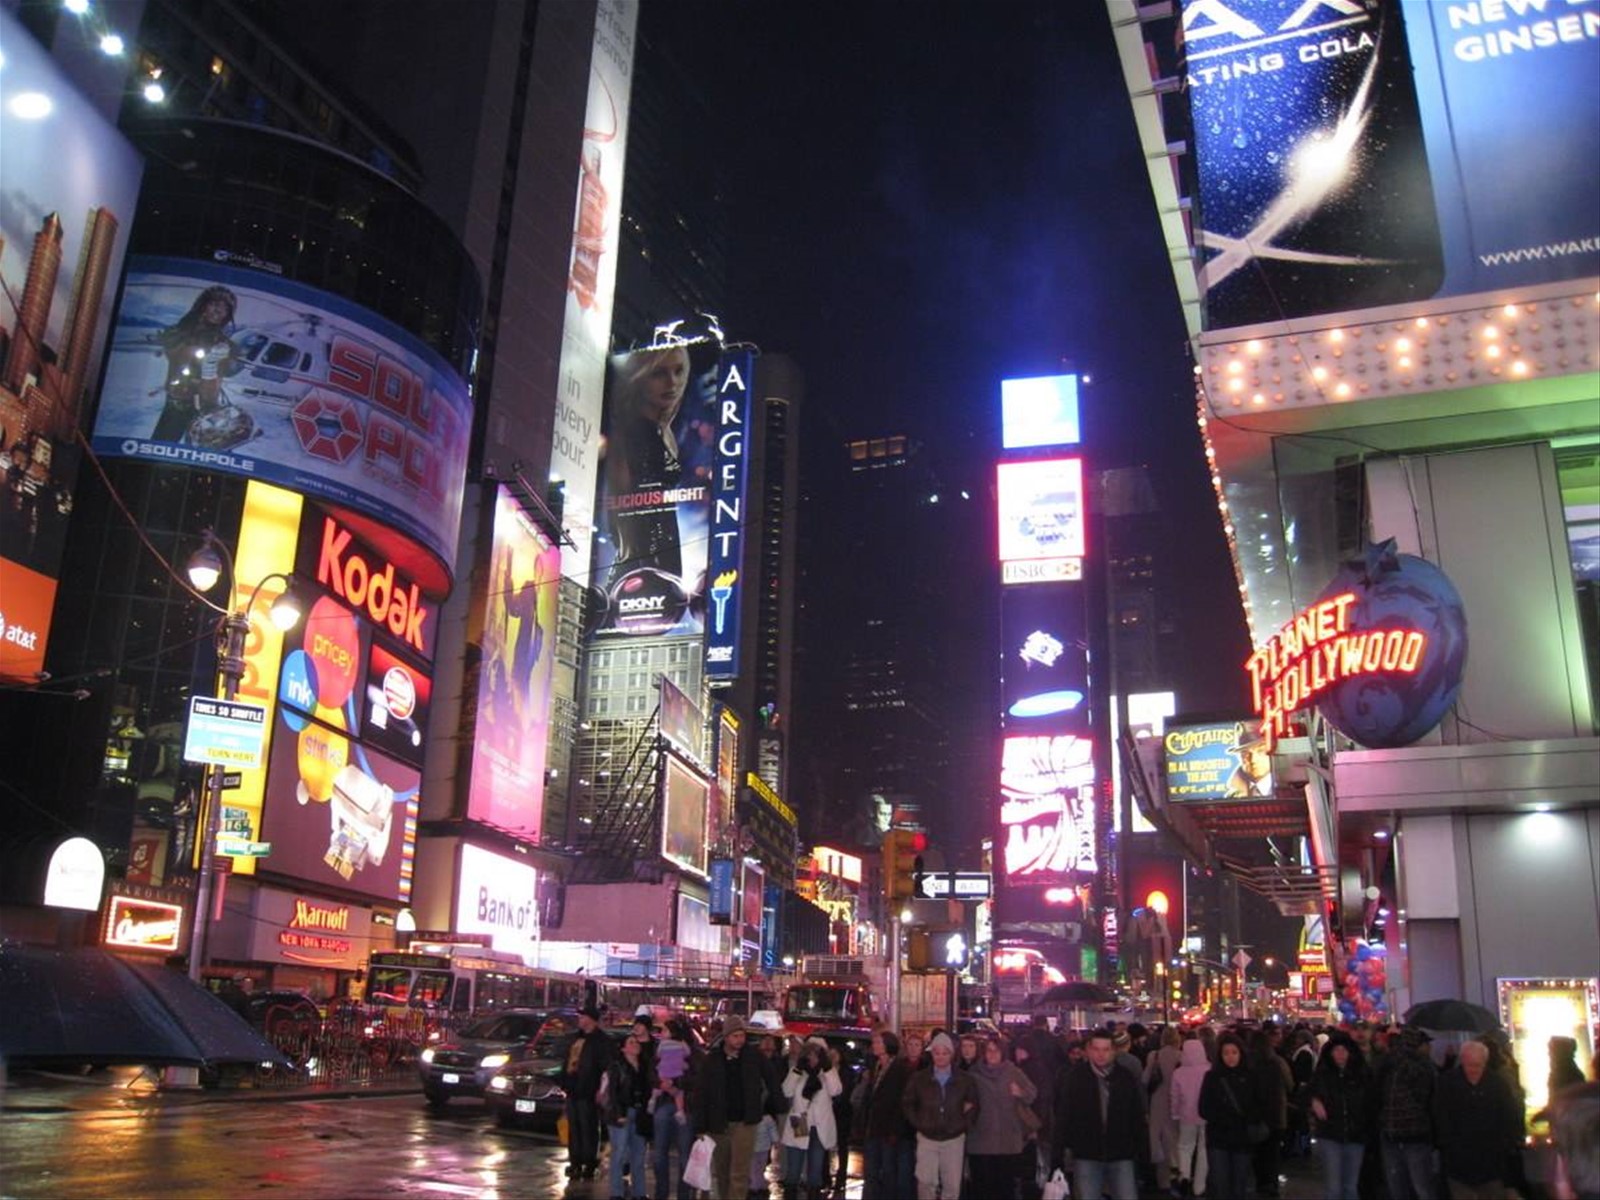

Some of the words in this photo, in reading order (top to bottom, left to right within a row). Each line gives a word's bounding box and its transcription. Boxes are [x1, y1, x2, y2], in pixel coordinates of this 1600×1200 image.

[1448, 0, 1546, 29] NEW
[1299, 32, 1374, 63] COLA
[567, 370, 580, 400] in
[140, 443, 254, 471] SOUTHPOLE
[714, 364, 746, 558] ARGENT
[662, 487, 706, 504] NIGHT
[318, 516, 427, 652] Kodak
[619, 595, 666, 611] DKNY
[6, 625, 37, 651] at&t
[1245, 593, 1355, 713] PLANET
[312, 634, 354, 676] pricey
[287, 672, 313, 709] ink
[1259, 629, 1424, 752] HOLLYWOOD
[290, 900, 349, 931] Marriott
[478, 886, 514, 929] Bank
